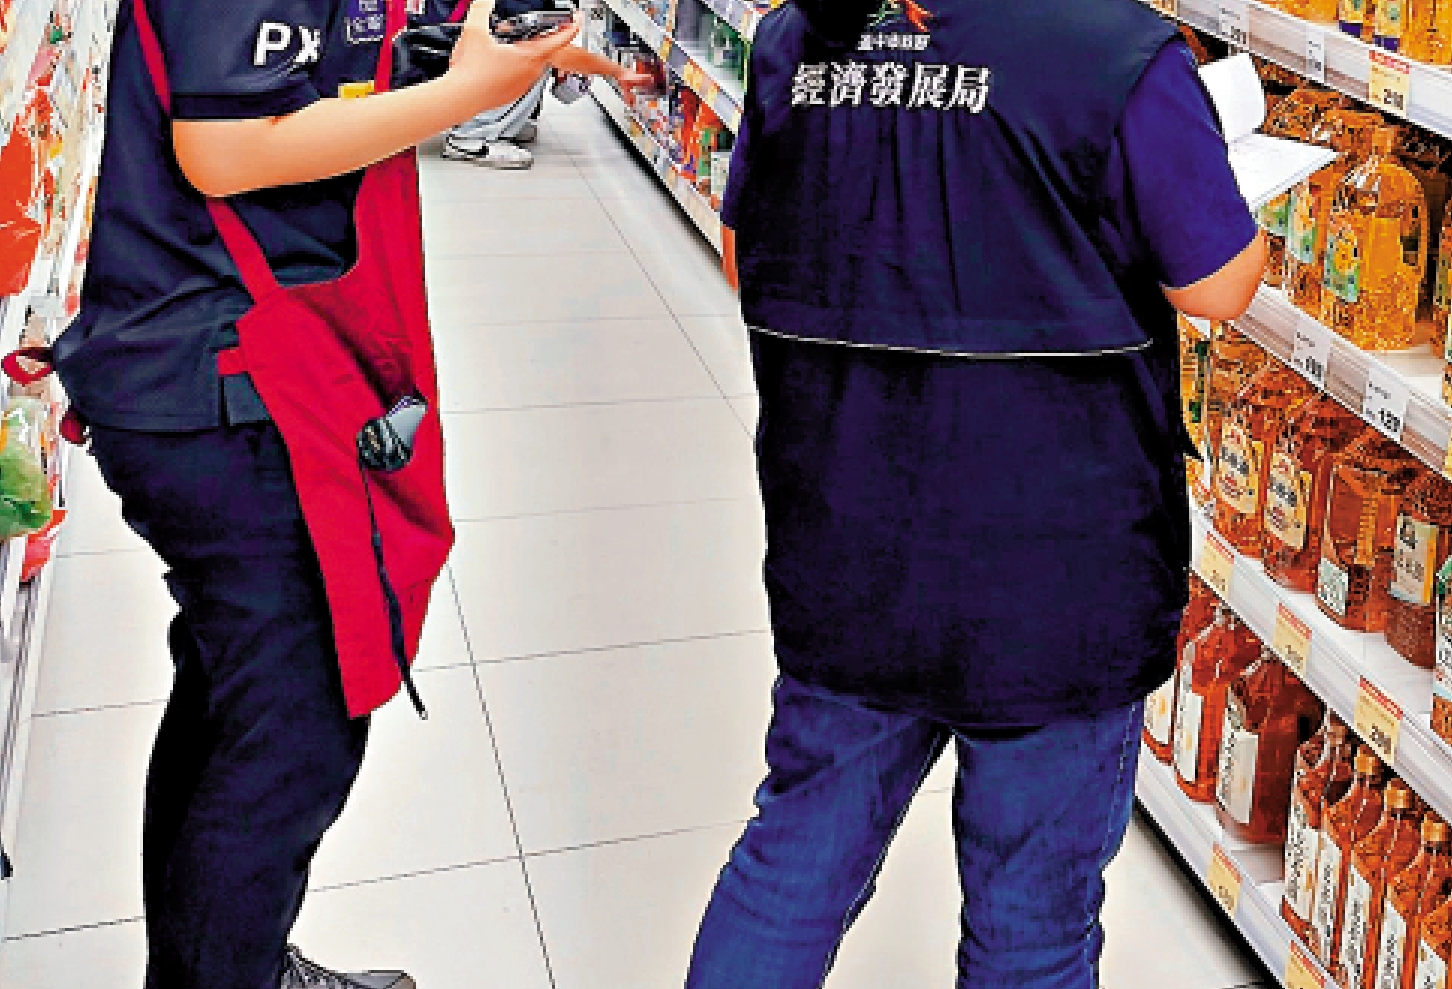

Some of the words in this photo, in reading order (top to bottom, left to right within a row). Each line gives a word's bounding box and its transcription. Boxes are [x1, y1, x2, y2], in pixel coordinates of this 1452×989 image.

[791, 60, 990, 114] 經濟發展局
